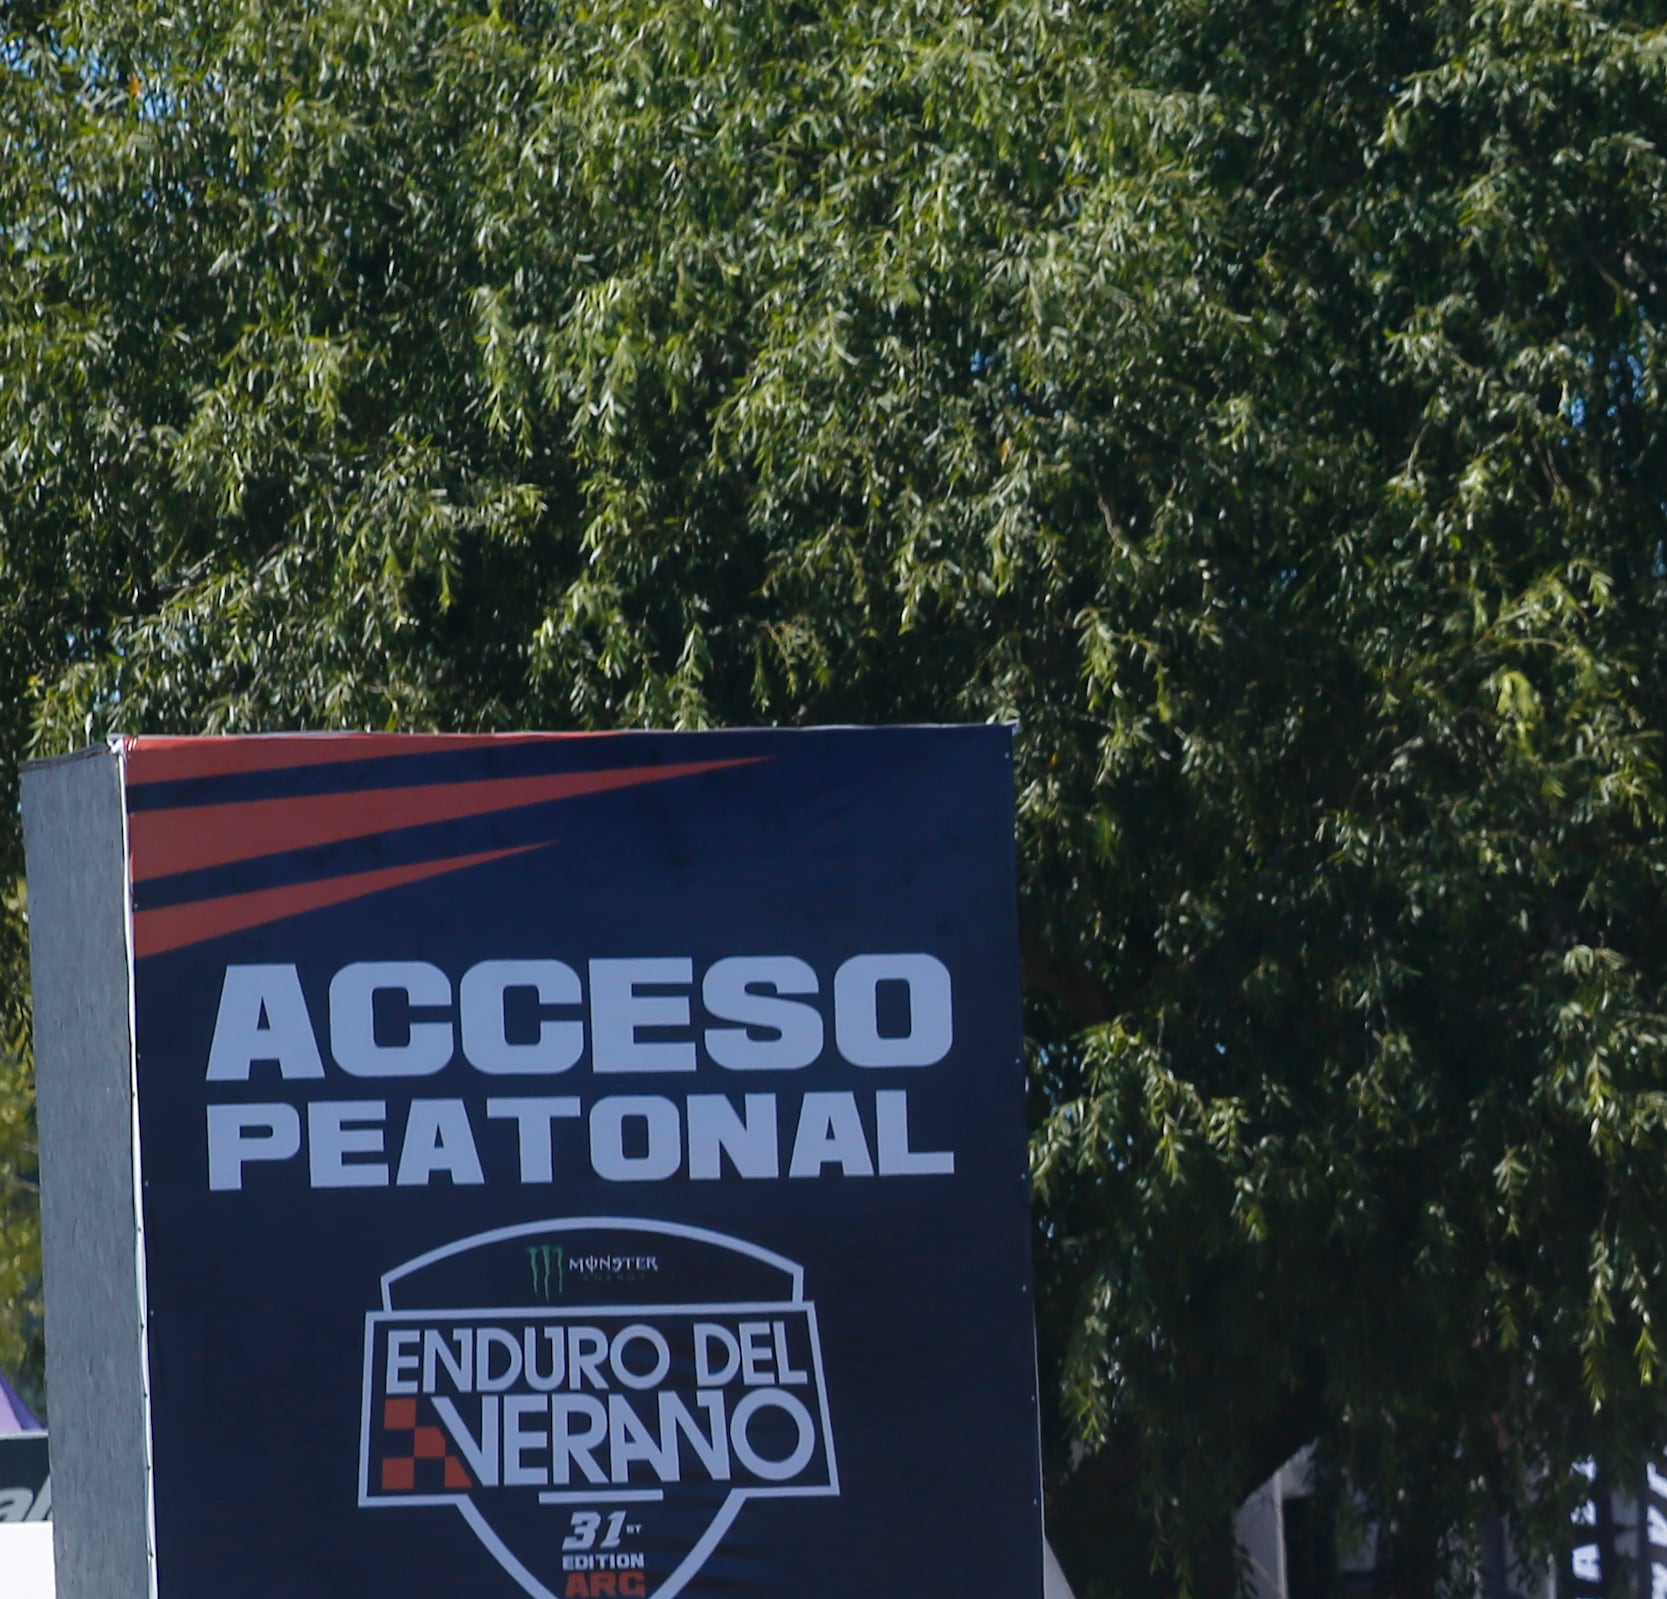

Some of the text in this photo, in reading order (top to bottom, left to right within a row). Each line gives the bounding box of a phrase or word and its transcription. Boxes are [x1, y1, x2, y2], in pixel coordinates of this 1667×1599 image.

[206, 953, 953, 1082] ACCESO
[208, 1090, 955, 1192] PEATONAL
[568, 1254, 659, 1275] MONSTER
[386, 1320, 808, 1394] ENDURO DEL
[430, 1387, 816, 1487] VERANO
[562, 1552, 645, 1571] EDITION
[564, 1571, 647, 1599] ARG
